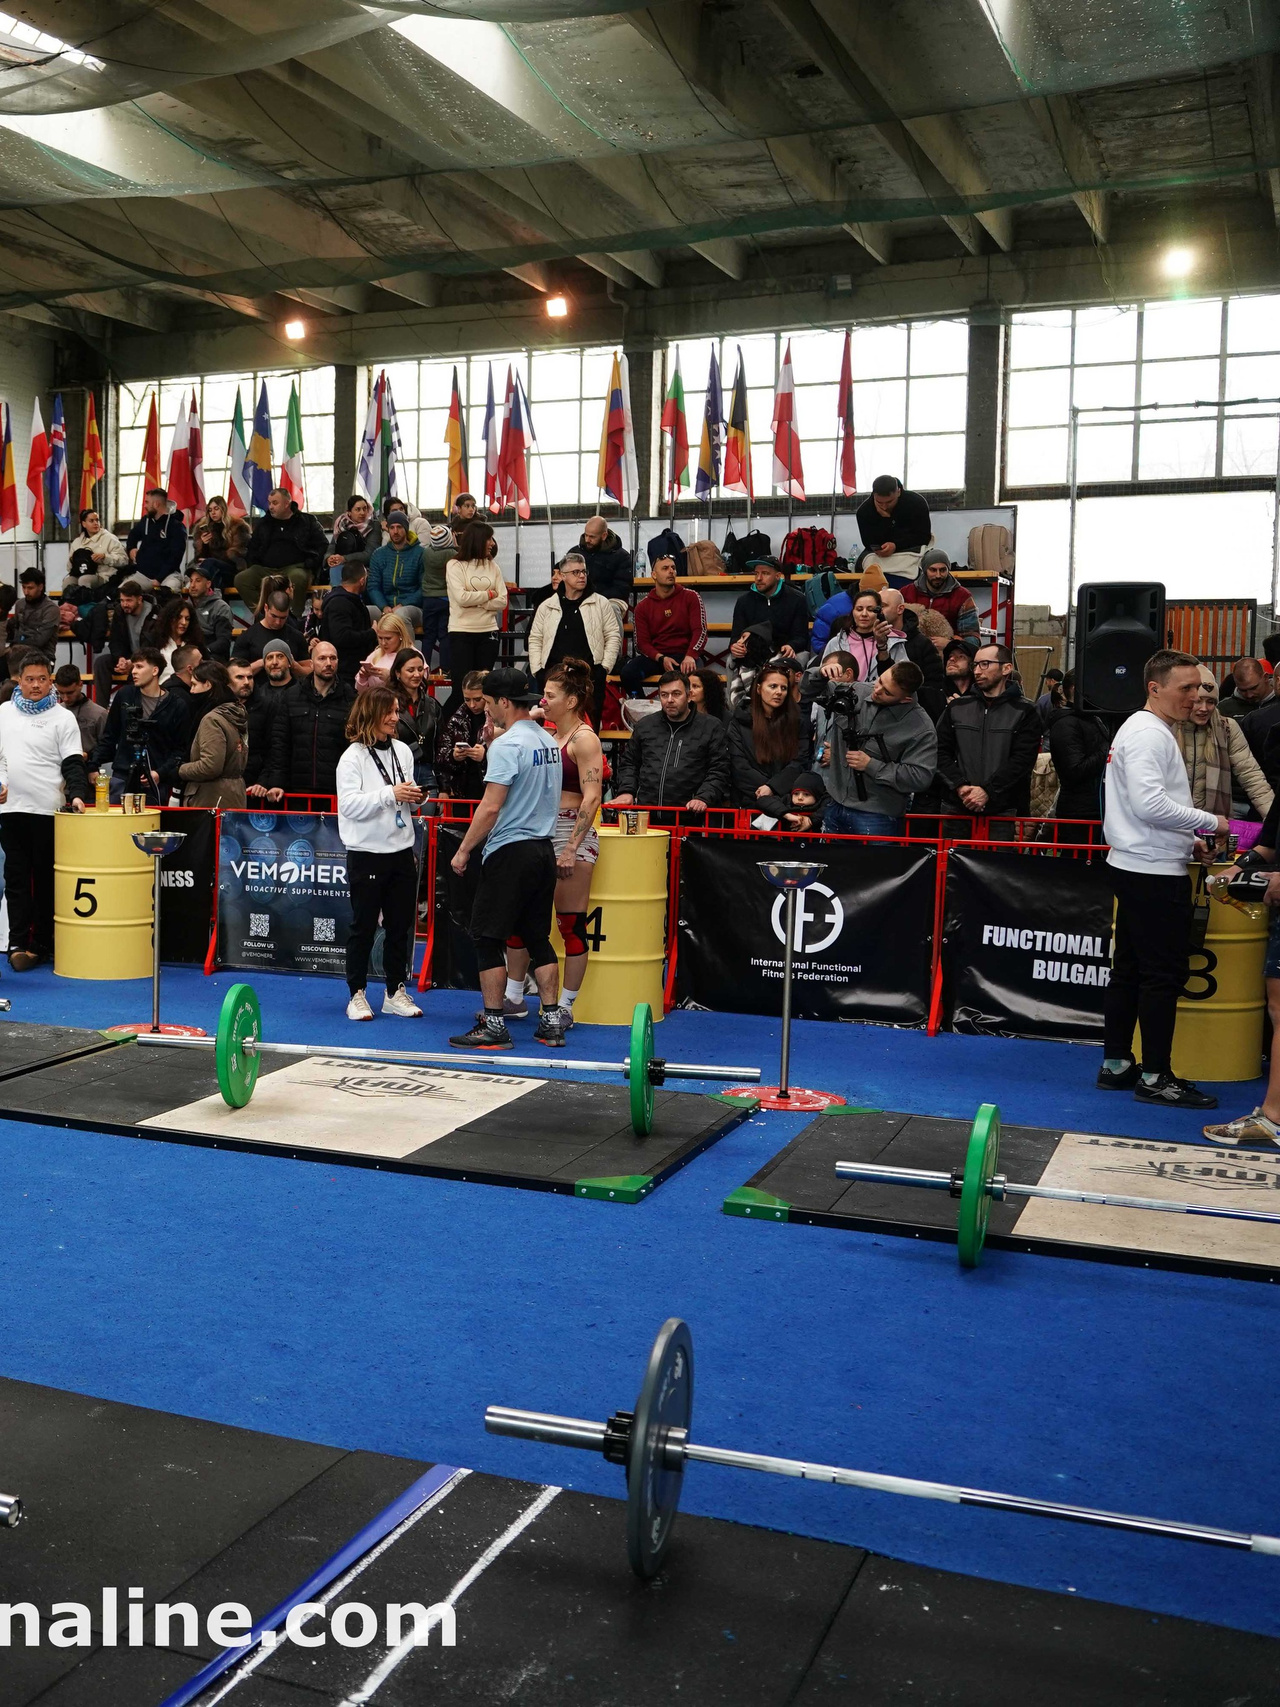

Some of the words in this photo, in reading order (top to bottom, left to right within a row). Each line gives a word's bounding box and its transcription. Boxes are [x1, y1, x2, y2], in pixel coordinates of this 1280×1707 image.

[160, 870, 195, 888] NESS
[230, 861, 348, 885] VEMOHER
[72, 878, 98, 918] 5
[245, 884, 288, 894] BIOACTIVE
[291, 887, 351, 898] SUPPLEMENTS
[586, 907, 607, 952] 4
[243, 941, 266, 949] FOLLOW
[301, 945, 329, 953] DISCOVER
[982, 924, 1104, 958] FUNCTIONAL
[797, 971, 849, 982] Federation
[811, 962, 862, 973] Functional
[1032, 959, 1111, 987] BULGAR
[1184, 948, 1218, 1000] 3
